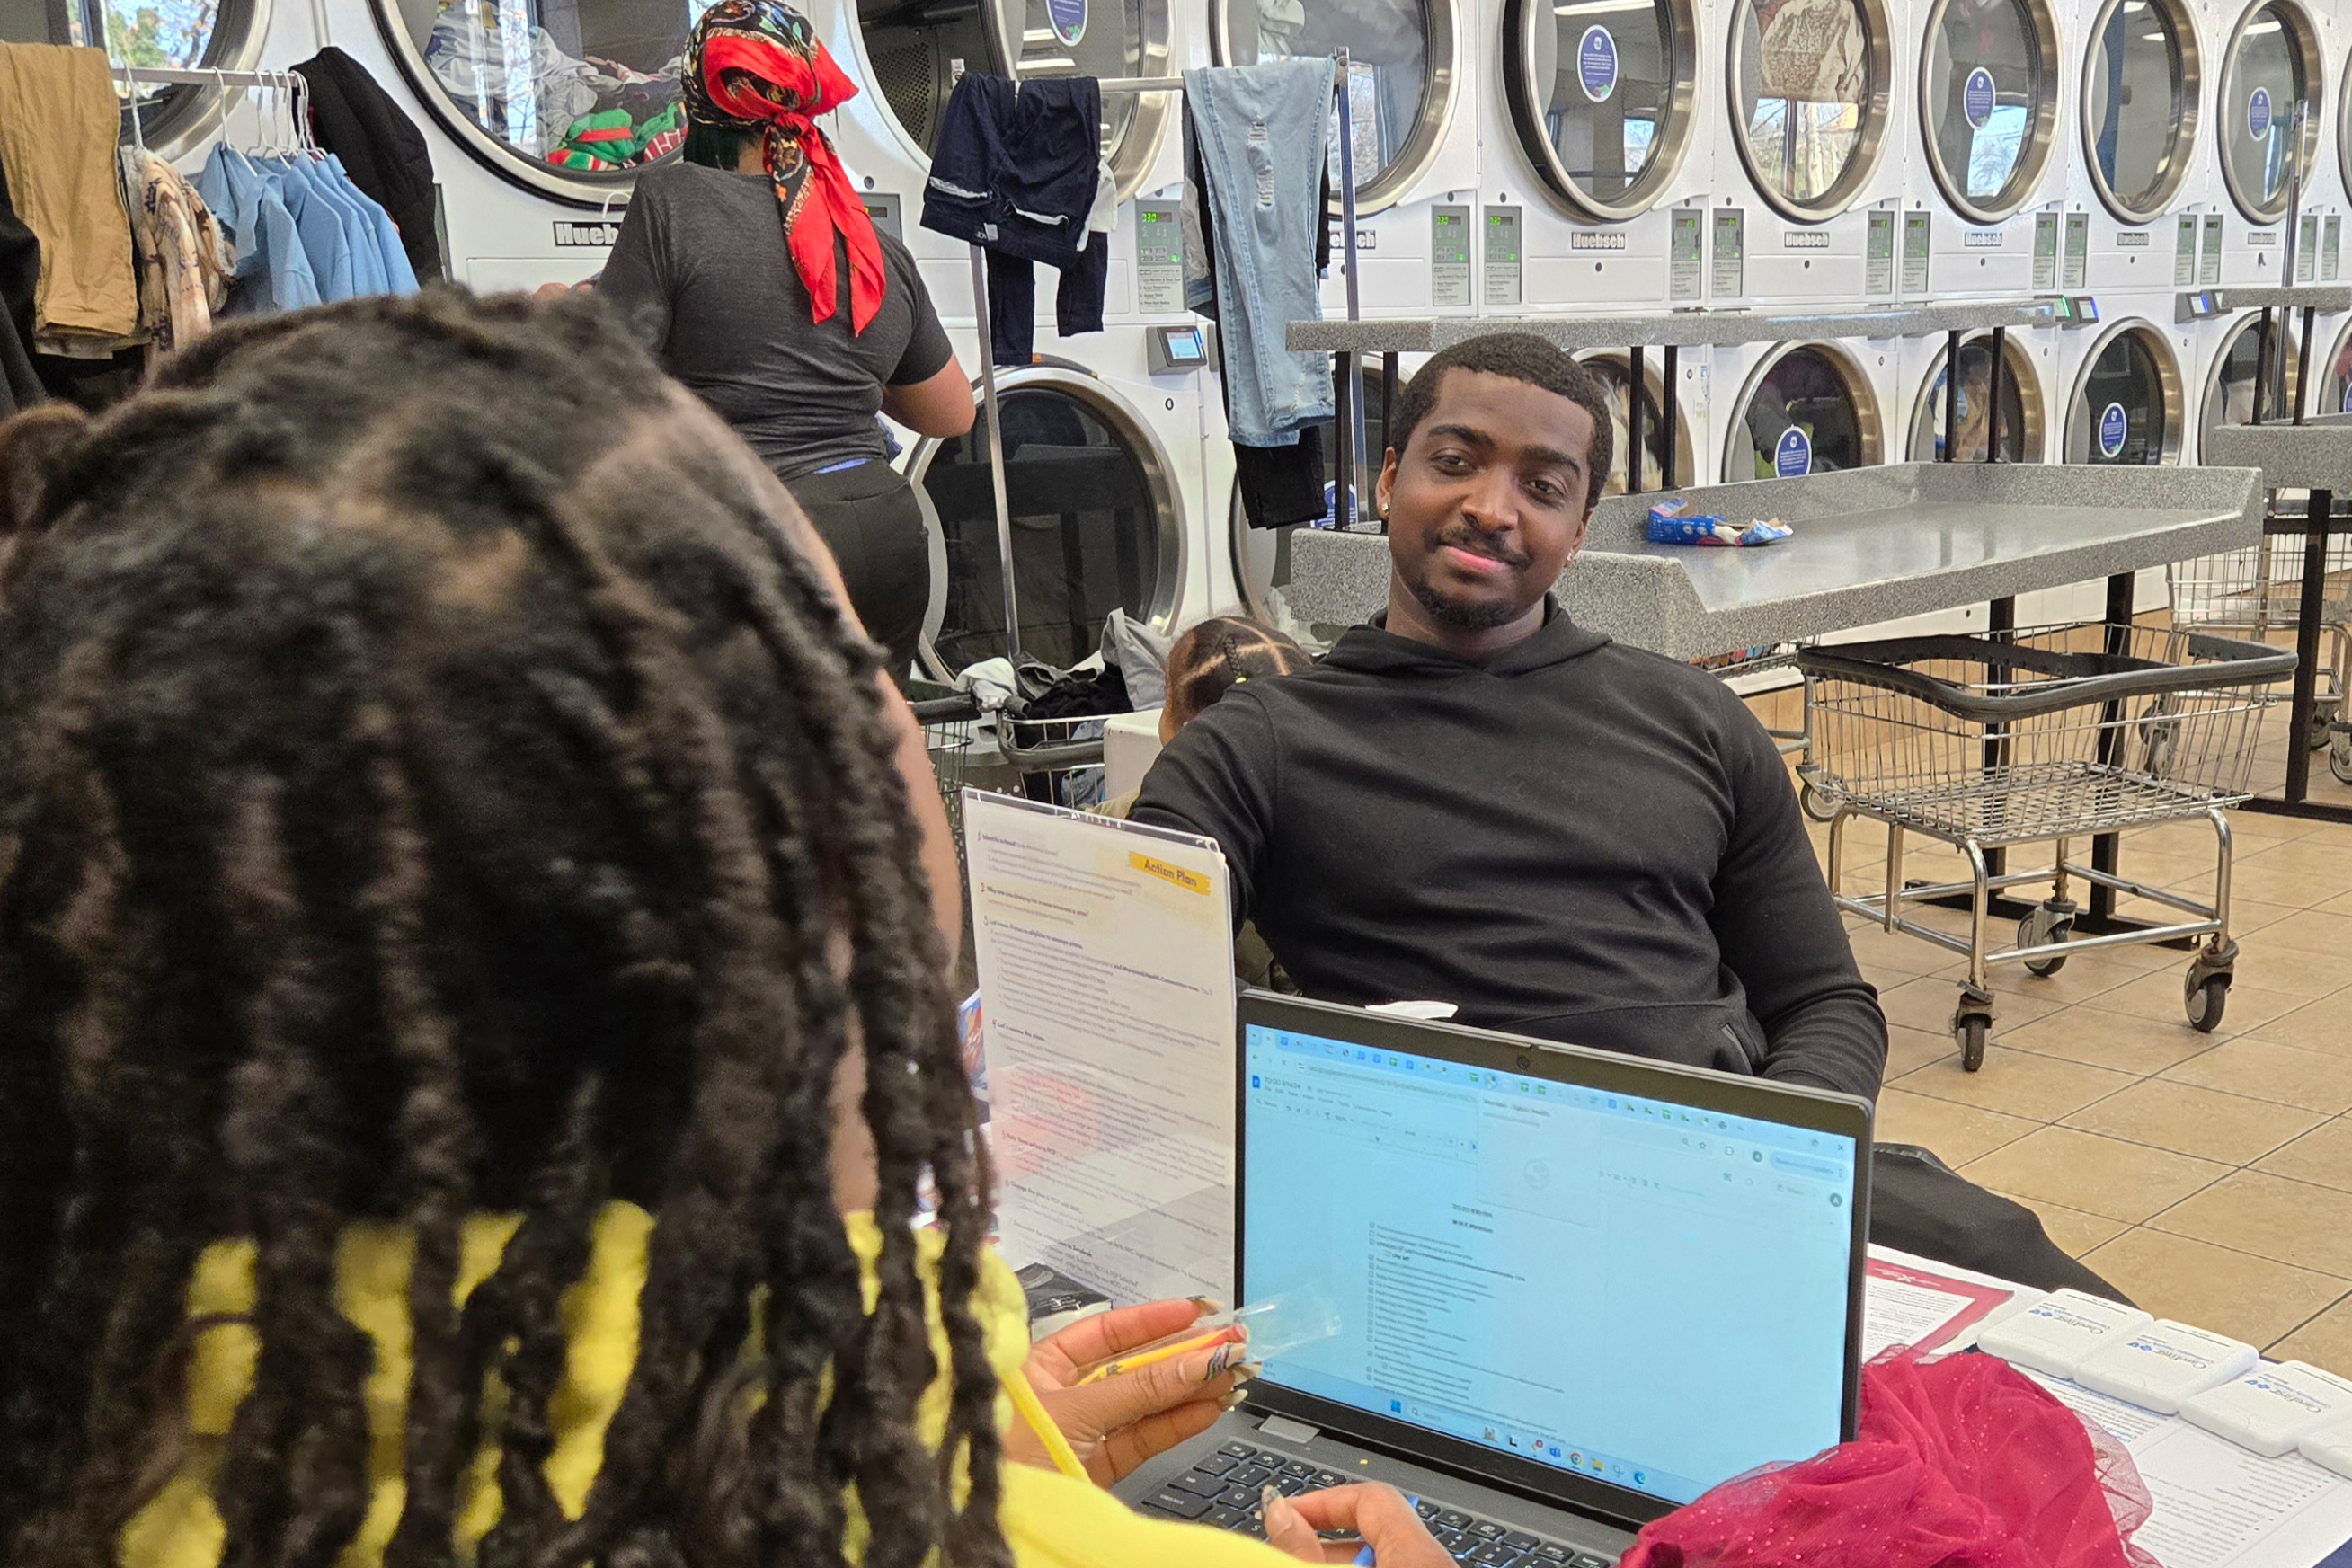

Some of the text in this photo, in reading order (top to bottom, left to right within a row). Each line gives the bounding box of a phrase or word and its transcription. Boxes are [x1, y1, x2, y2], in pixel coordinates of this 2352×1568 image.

[555, 223, 620, 244] Hueb
[1572, 233, 1625, 249] Huebsch
[1785, 232, 1829, 247] Huebsch
[1144, 858, 1197, 888] Action Plan
